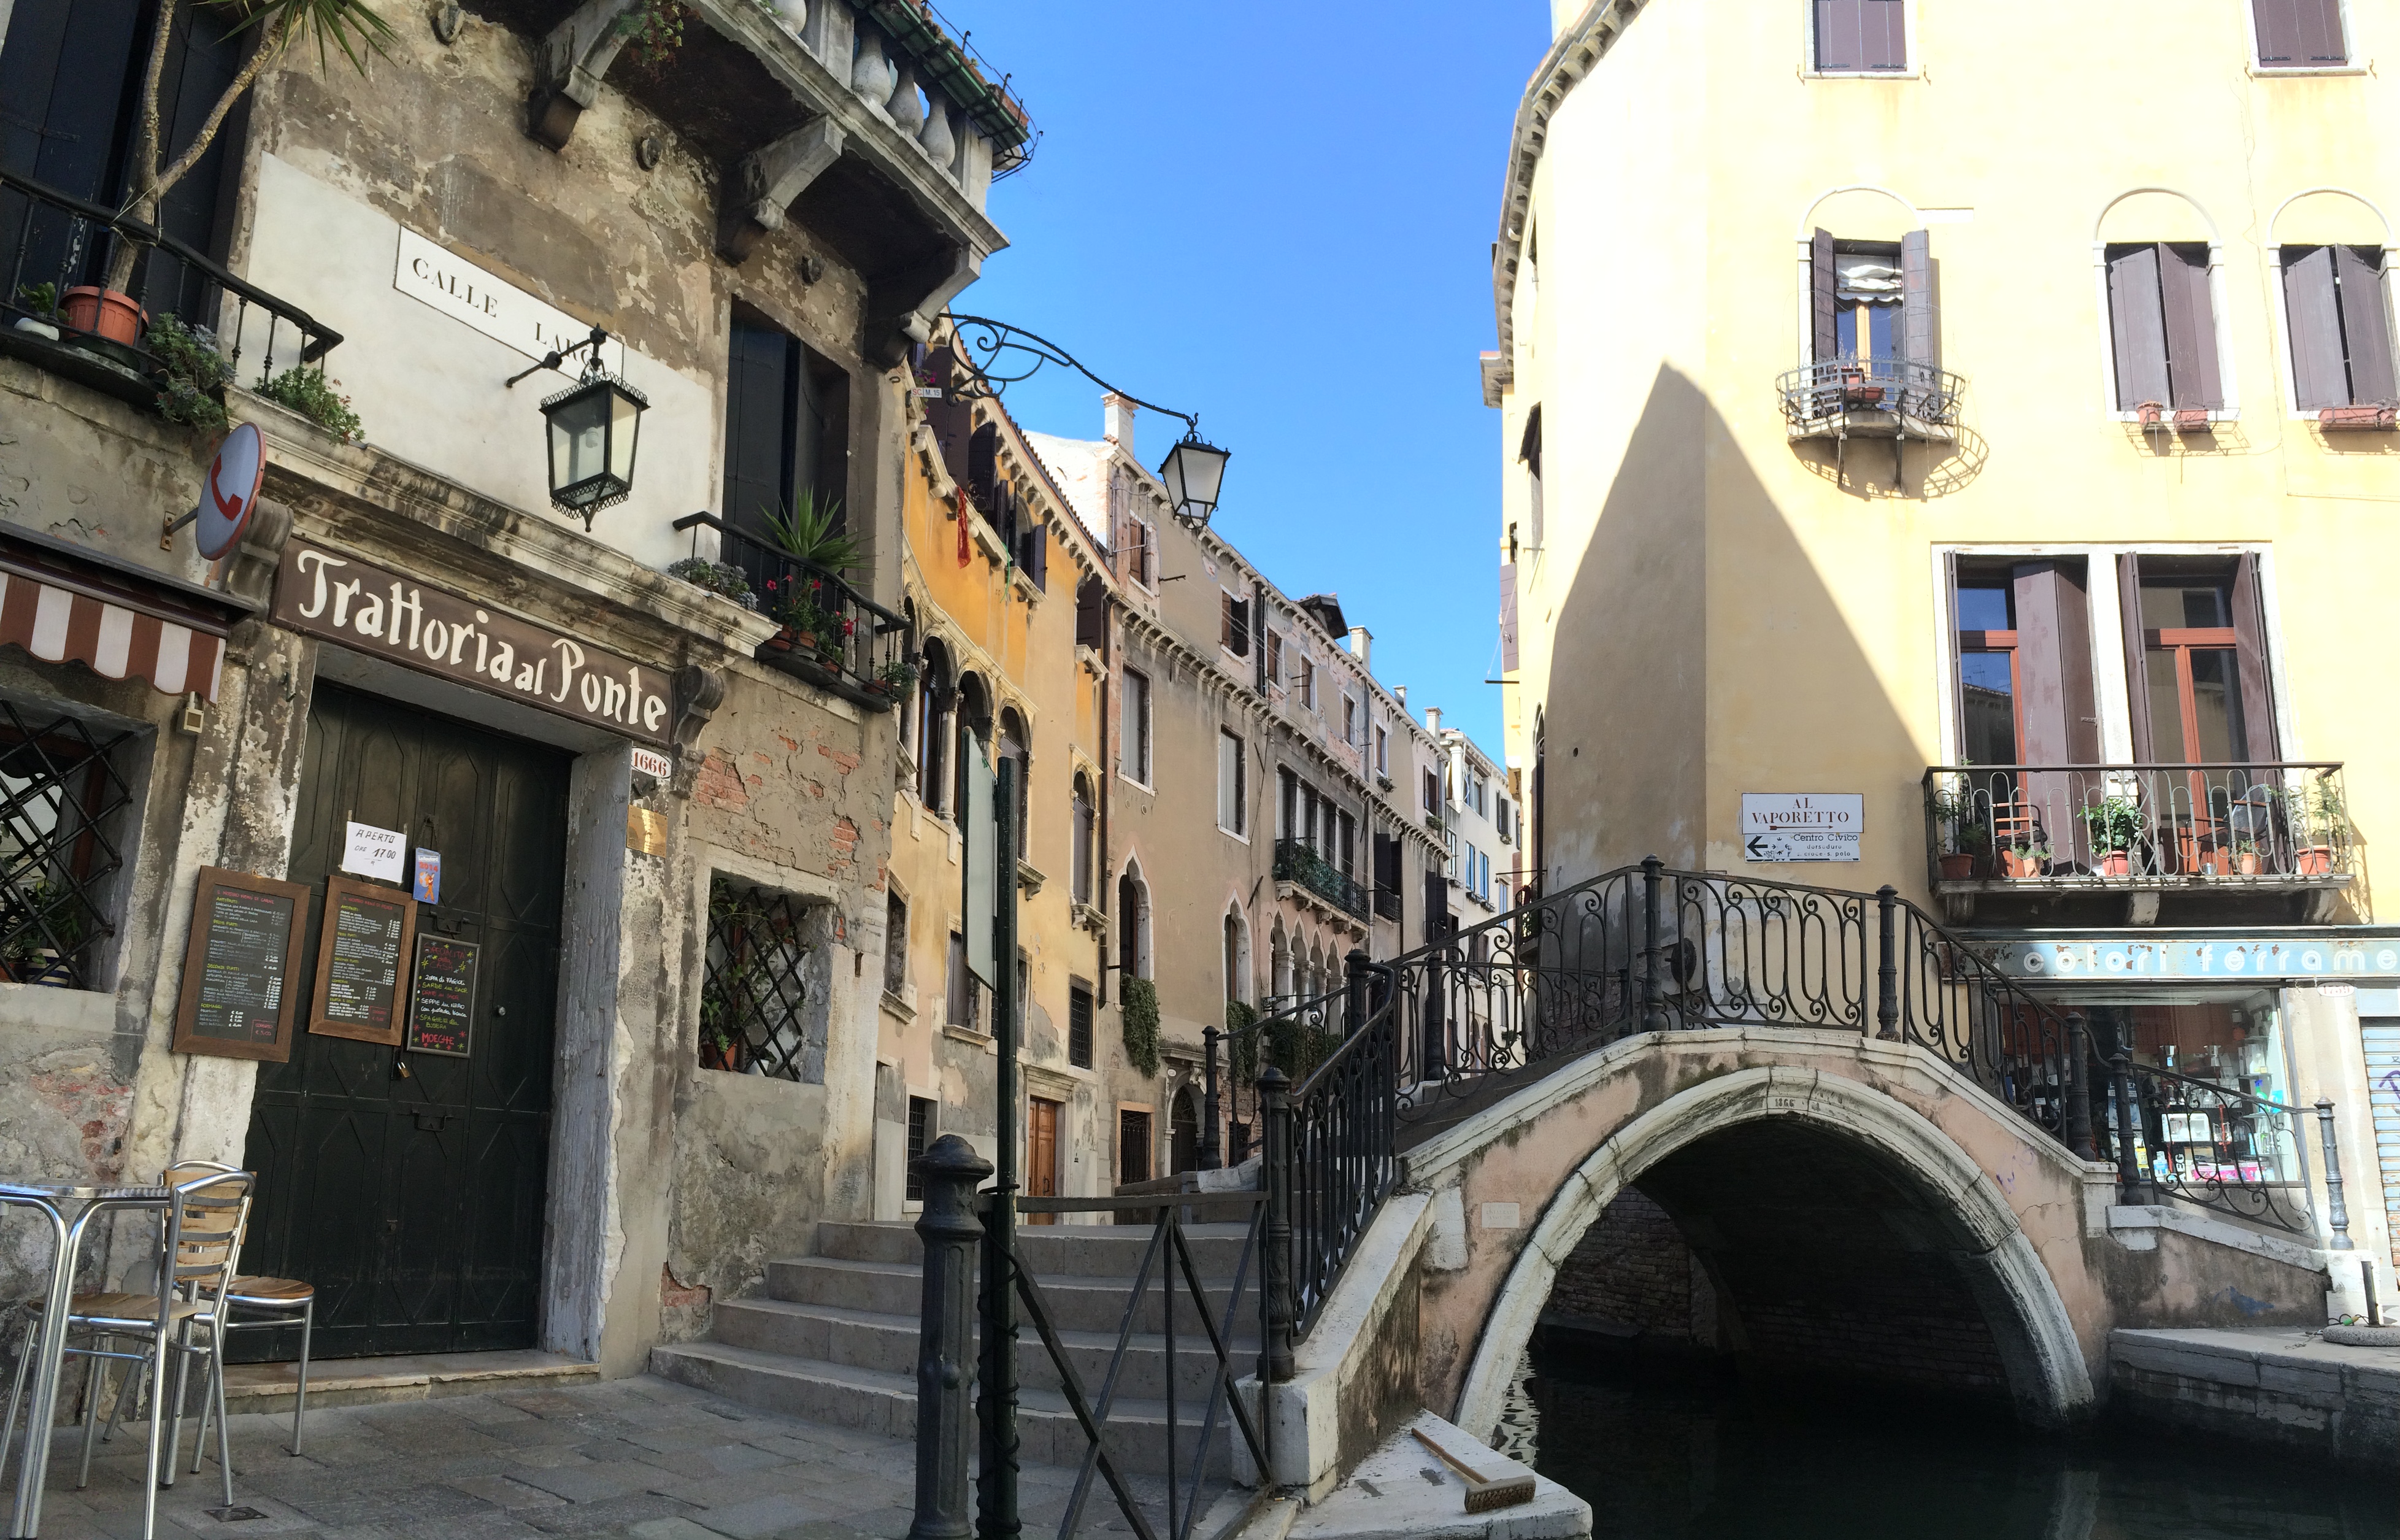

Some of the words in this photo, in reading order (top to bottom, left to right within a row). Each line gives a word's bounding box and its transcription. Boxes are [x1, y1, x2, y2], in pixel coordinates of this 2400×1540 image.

[412, 258, 498, 318] CALLE
[298, 550, 514, 682] Trattoria
[515, 658, 547, 695] al
[550, 637, 667, 732] Ponte
[634, 752, 667, 777] 1666
[1793, 797, 1813, 809] AL
[1752, 811, 1849, 823] VAPORETTO
[356, 829, 395, 844] APERTO
[419, 861, 438, 872] 2014
[2175, 1153, 2187, 1182] AEG
